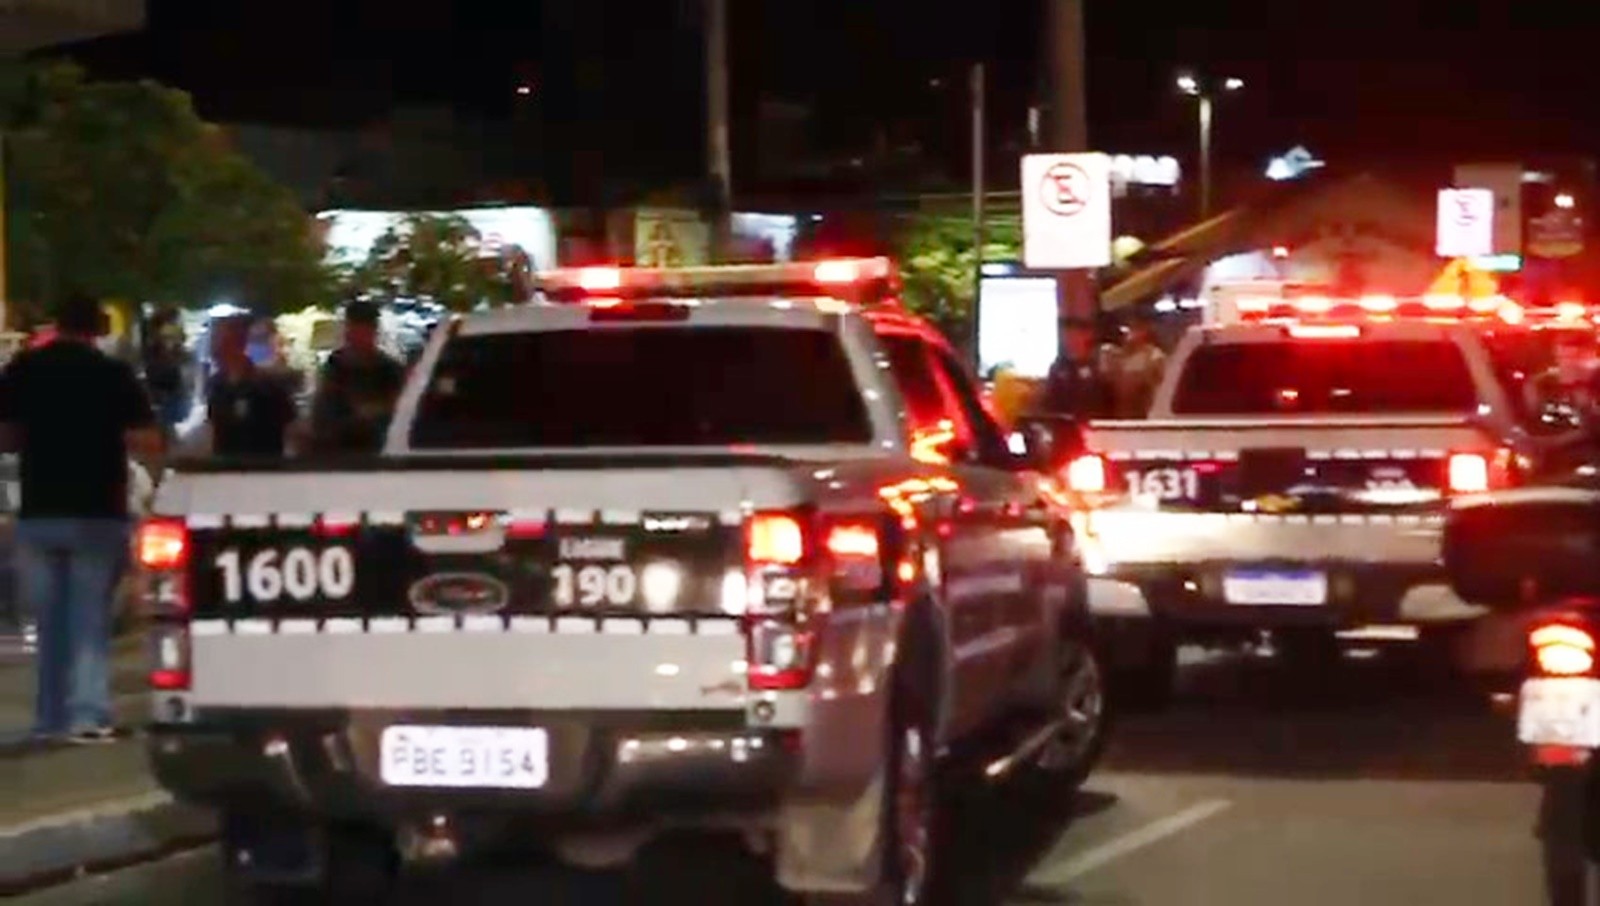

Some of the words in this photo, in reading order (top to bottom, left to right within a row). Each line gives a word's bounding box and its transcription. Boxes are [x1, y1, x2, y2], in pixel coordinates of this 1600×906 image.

[1125, 468, 1197, 503] 1631
[215, 546, 354, 601] 1600
[551, 563, 636, 606] 190
